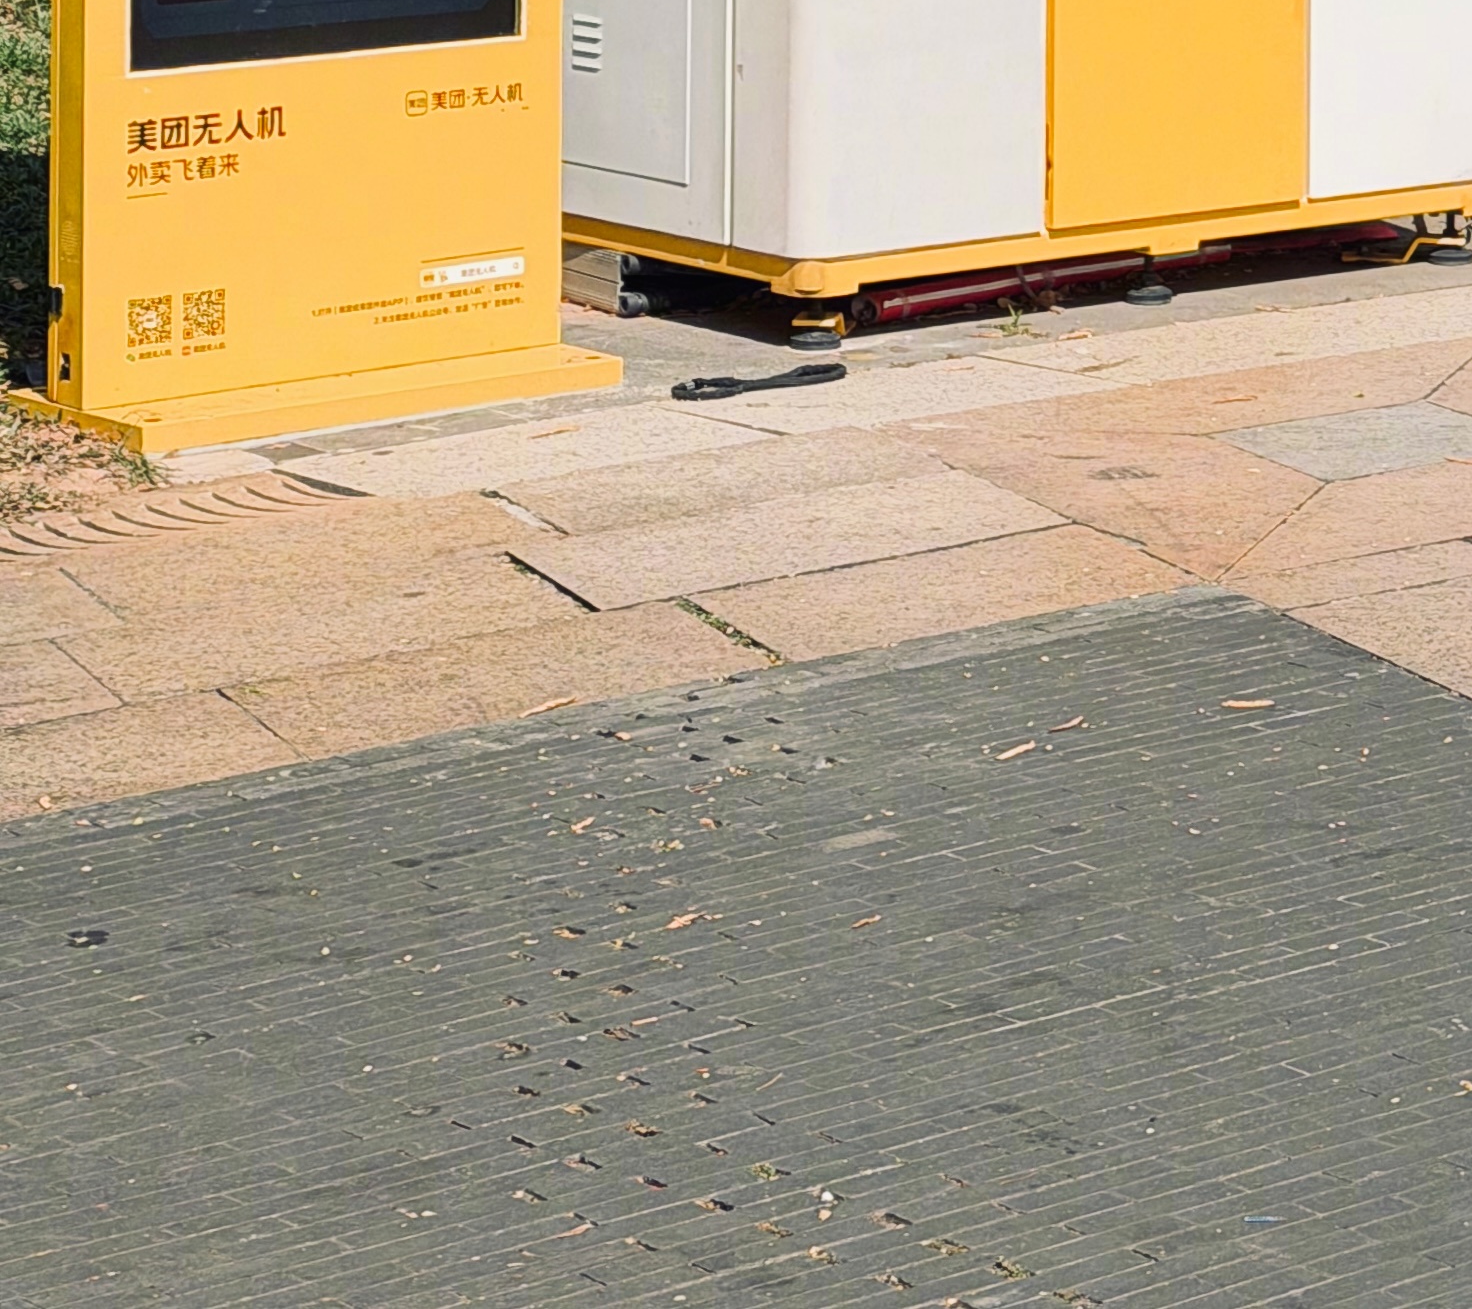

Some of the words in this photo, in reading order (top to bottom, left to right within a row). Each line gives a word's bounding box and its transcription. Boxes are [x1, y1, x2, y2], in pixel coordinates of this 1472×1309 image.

[127, 105, 287, 155] 美团无人机
[126, 152, 240, 188] 外卖飞着来
